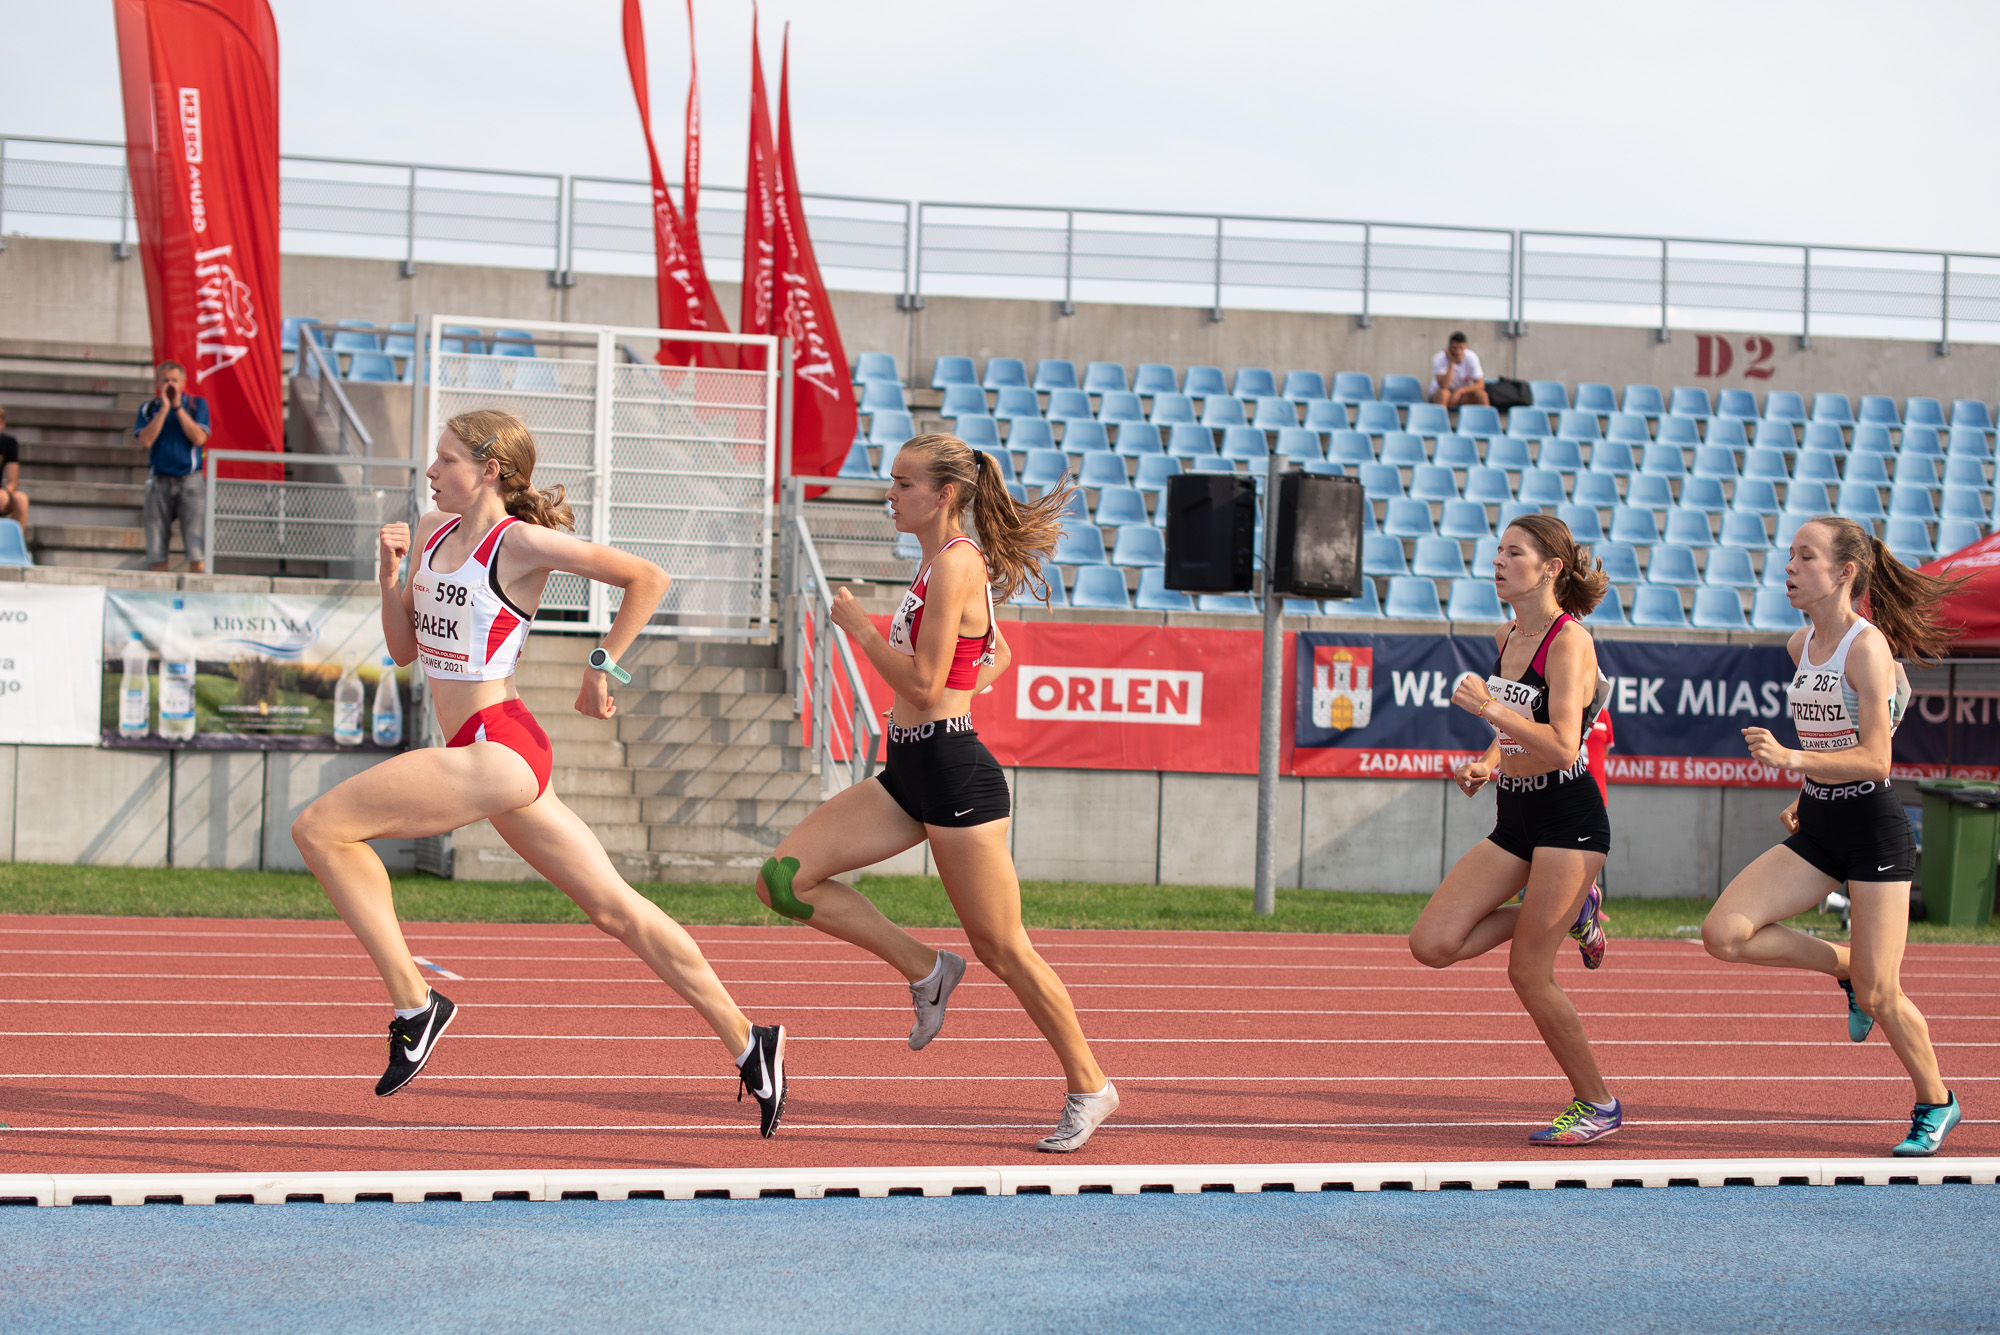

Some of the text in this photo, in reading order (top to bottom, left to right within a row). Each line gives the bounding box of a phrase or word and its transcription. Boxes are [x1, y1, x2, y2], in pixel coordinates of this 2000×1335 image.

[435, 582, 468, 607] 598
[414, 611, 459, 640] BIAŁEK
[444, 662, 464, 673] 2021
[1028, 675, 1189, 715] ORLEN
[1504, 684, 1531, 705] 550
[1813, 673, 1839, 692] 287
[1677, 678, 1794, 718] MIAST
[1790, 700, 1846, 721] TRZEŻYSZ
[900, 721, 935, 743] PRO
[945, 711, 974, 733] NIK
[1801, 737, 1853, 749] CŁAWEK 2021
[1359, 753, 1444, 772] ZADANIE
[1659, 760, 1680, 779] ZE
[1684, 756, 1780, 782] ŚRODKÓW
[1512, 774, 1548, 793] PRO
[1559, 756, 1587, 784] NIK
[1803, 780, 1830, 800] NIKE
[1831, 781, 1876, 801] PRO
